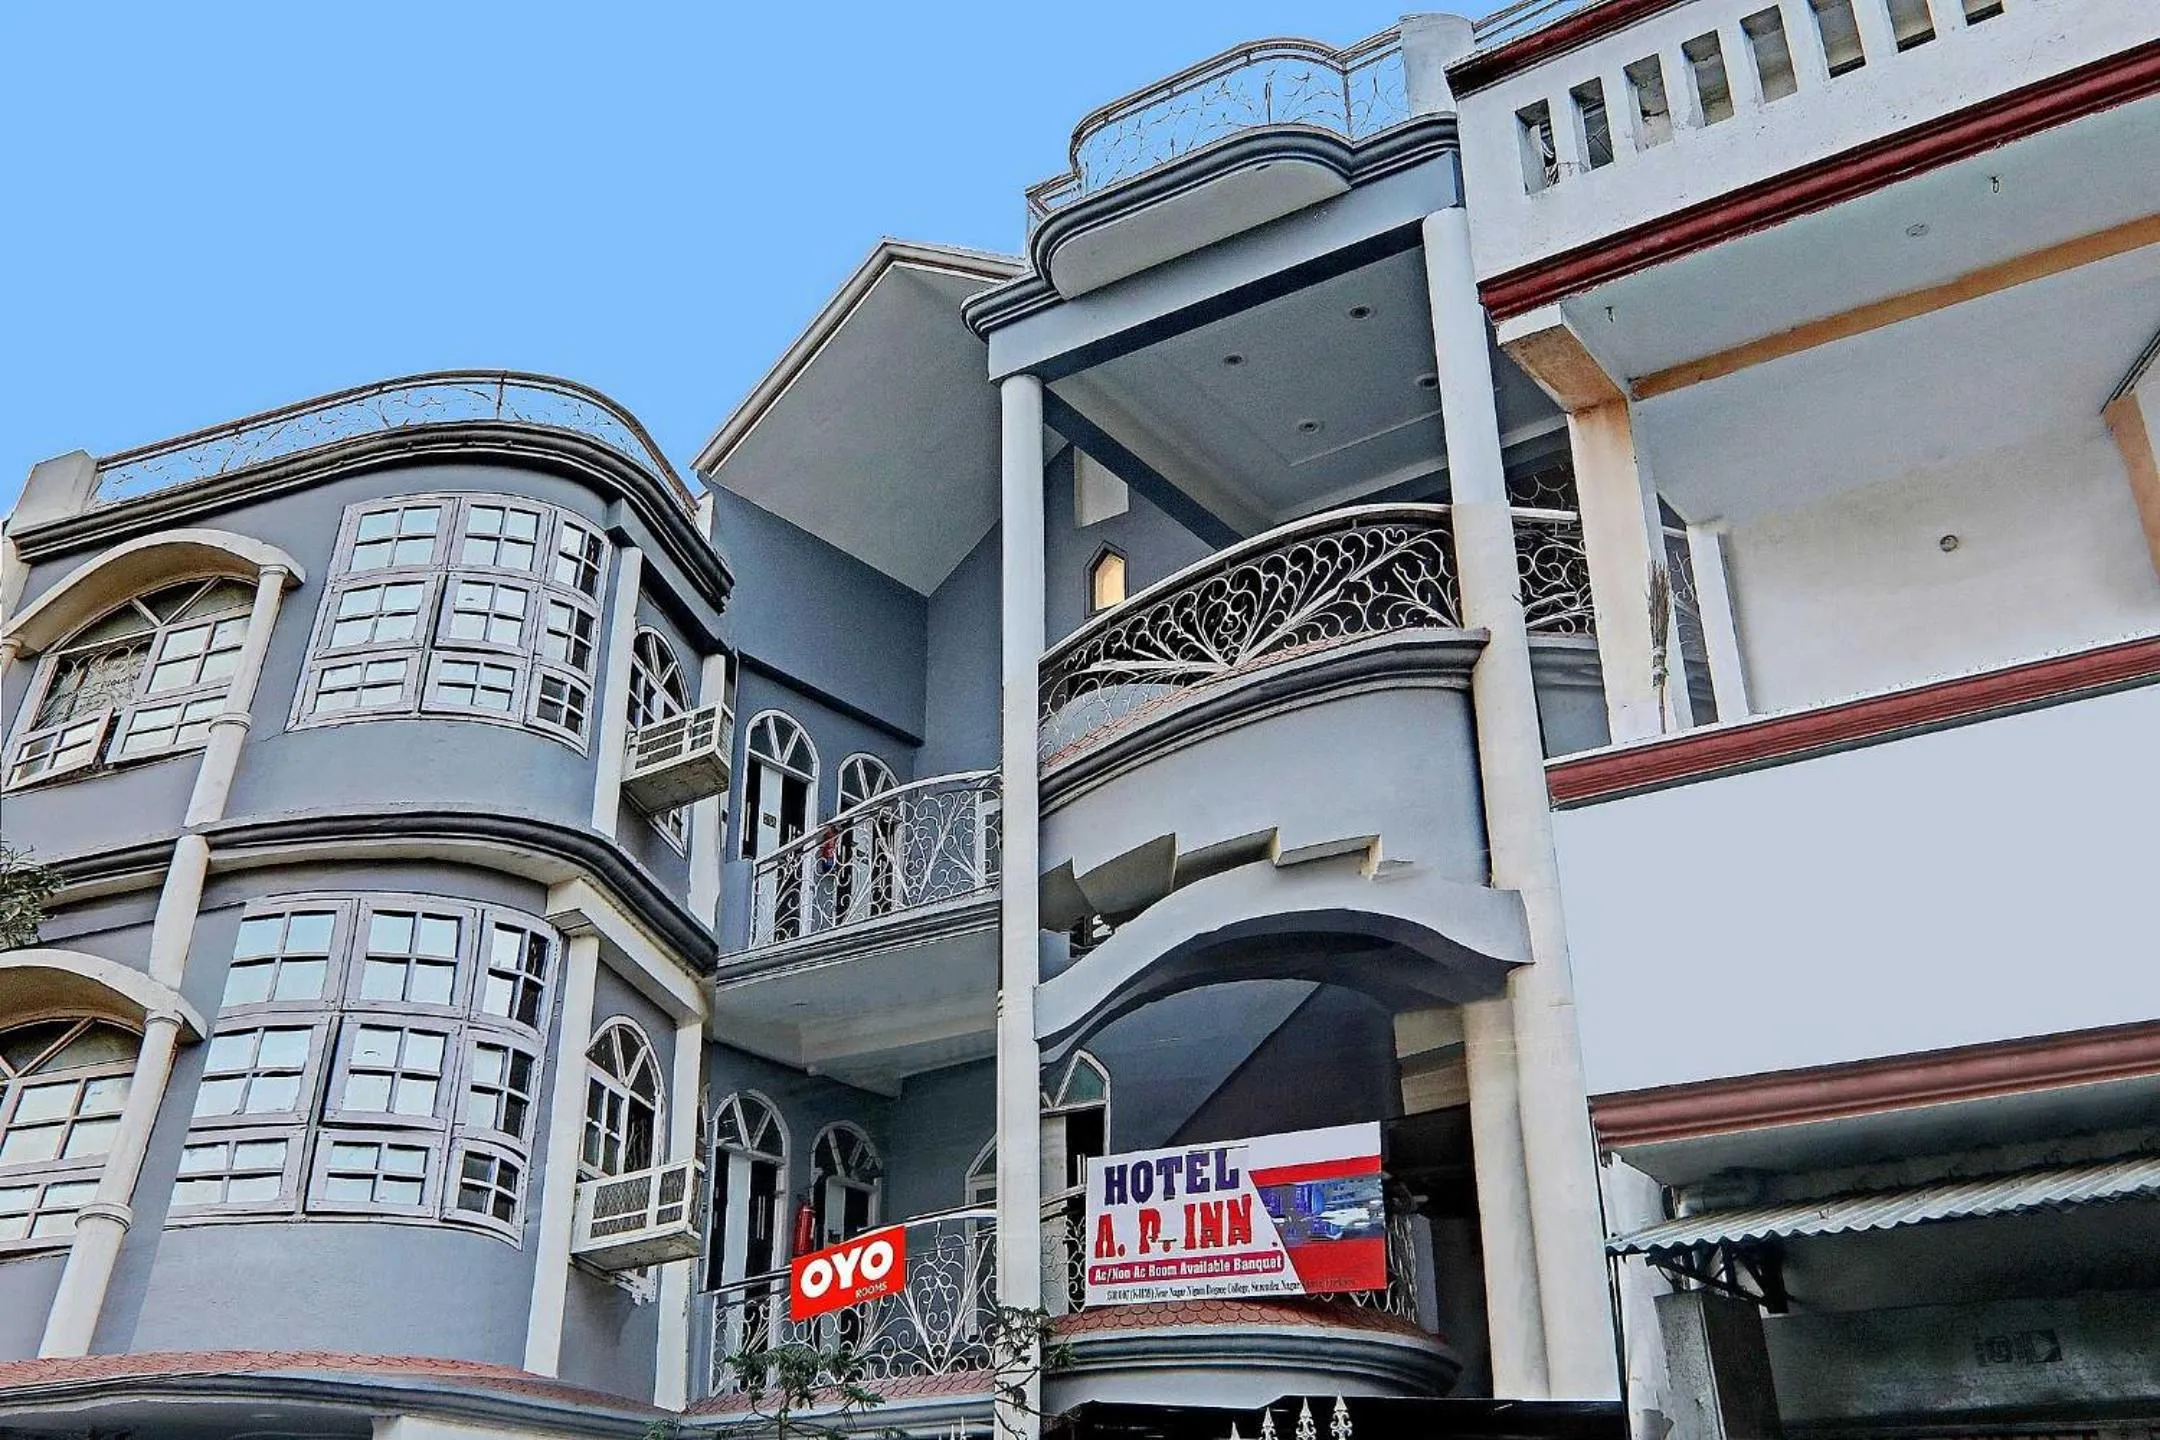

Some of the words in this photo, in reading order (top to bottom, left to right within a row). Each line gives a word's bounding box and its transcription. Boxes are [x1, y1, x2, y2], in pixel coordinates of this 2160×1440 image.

[1104, 1149, 1239, 1205] HOTEL
[1184, 1194, 1252, 1250] INN
[801, 1240, 893, 1298] OYO
[856, 1281, 888, 1299] ROOMS
[1134, 1266, 1146, 1278] Ac
[1180, 1258, 1230, 1275] Available
[1234, 1254, 1282, 1271] Banquet
